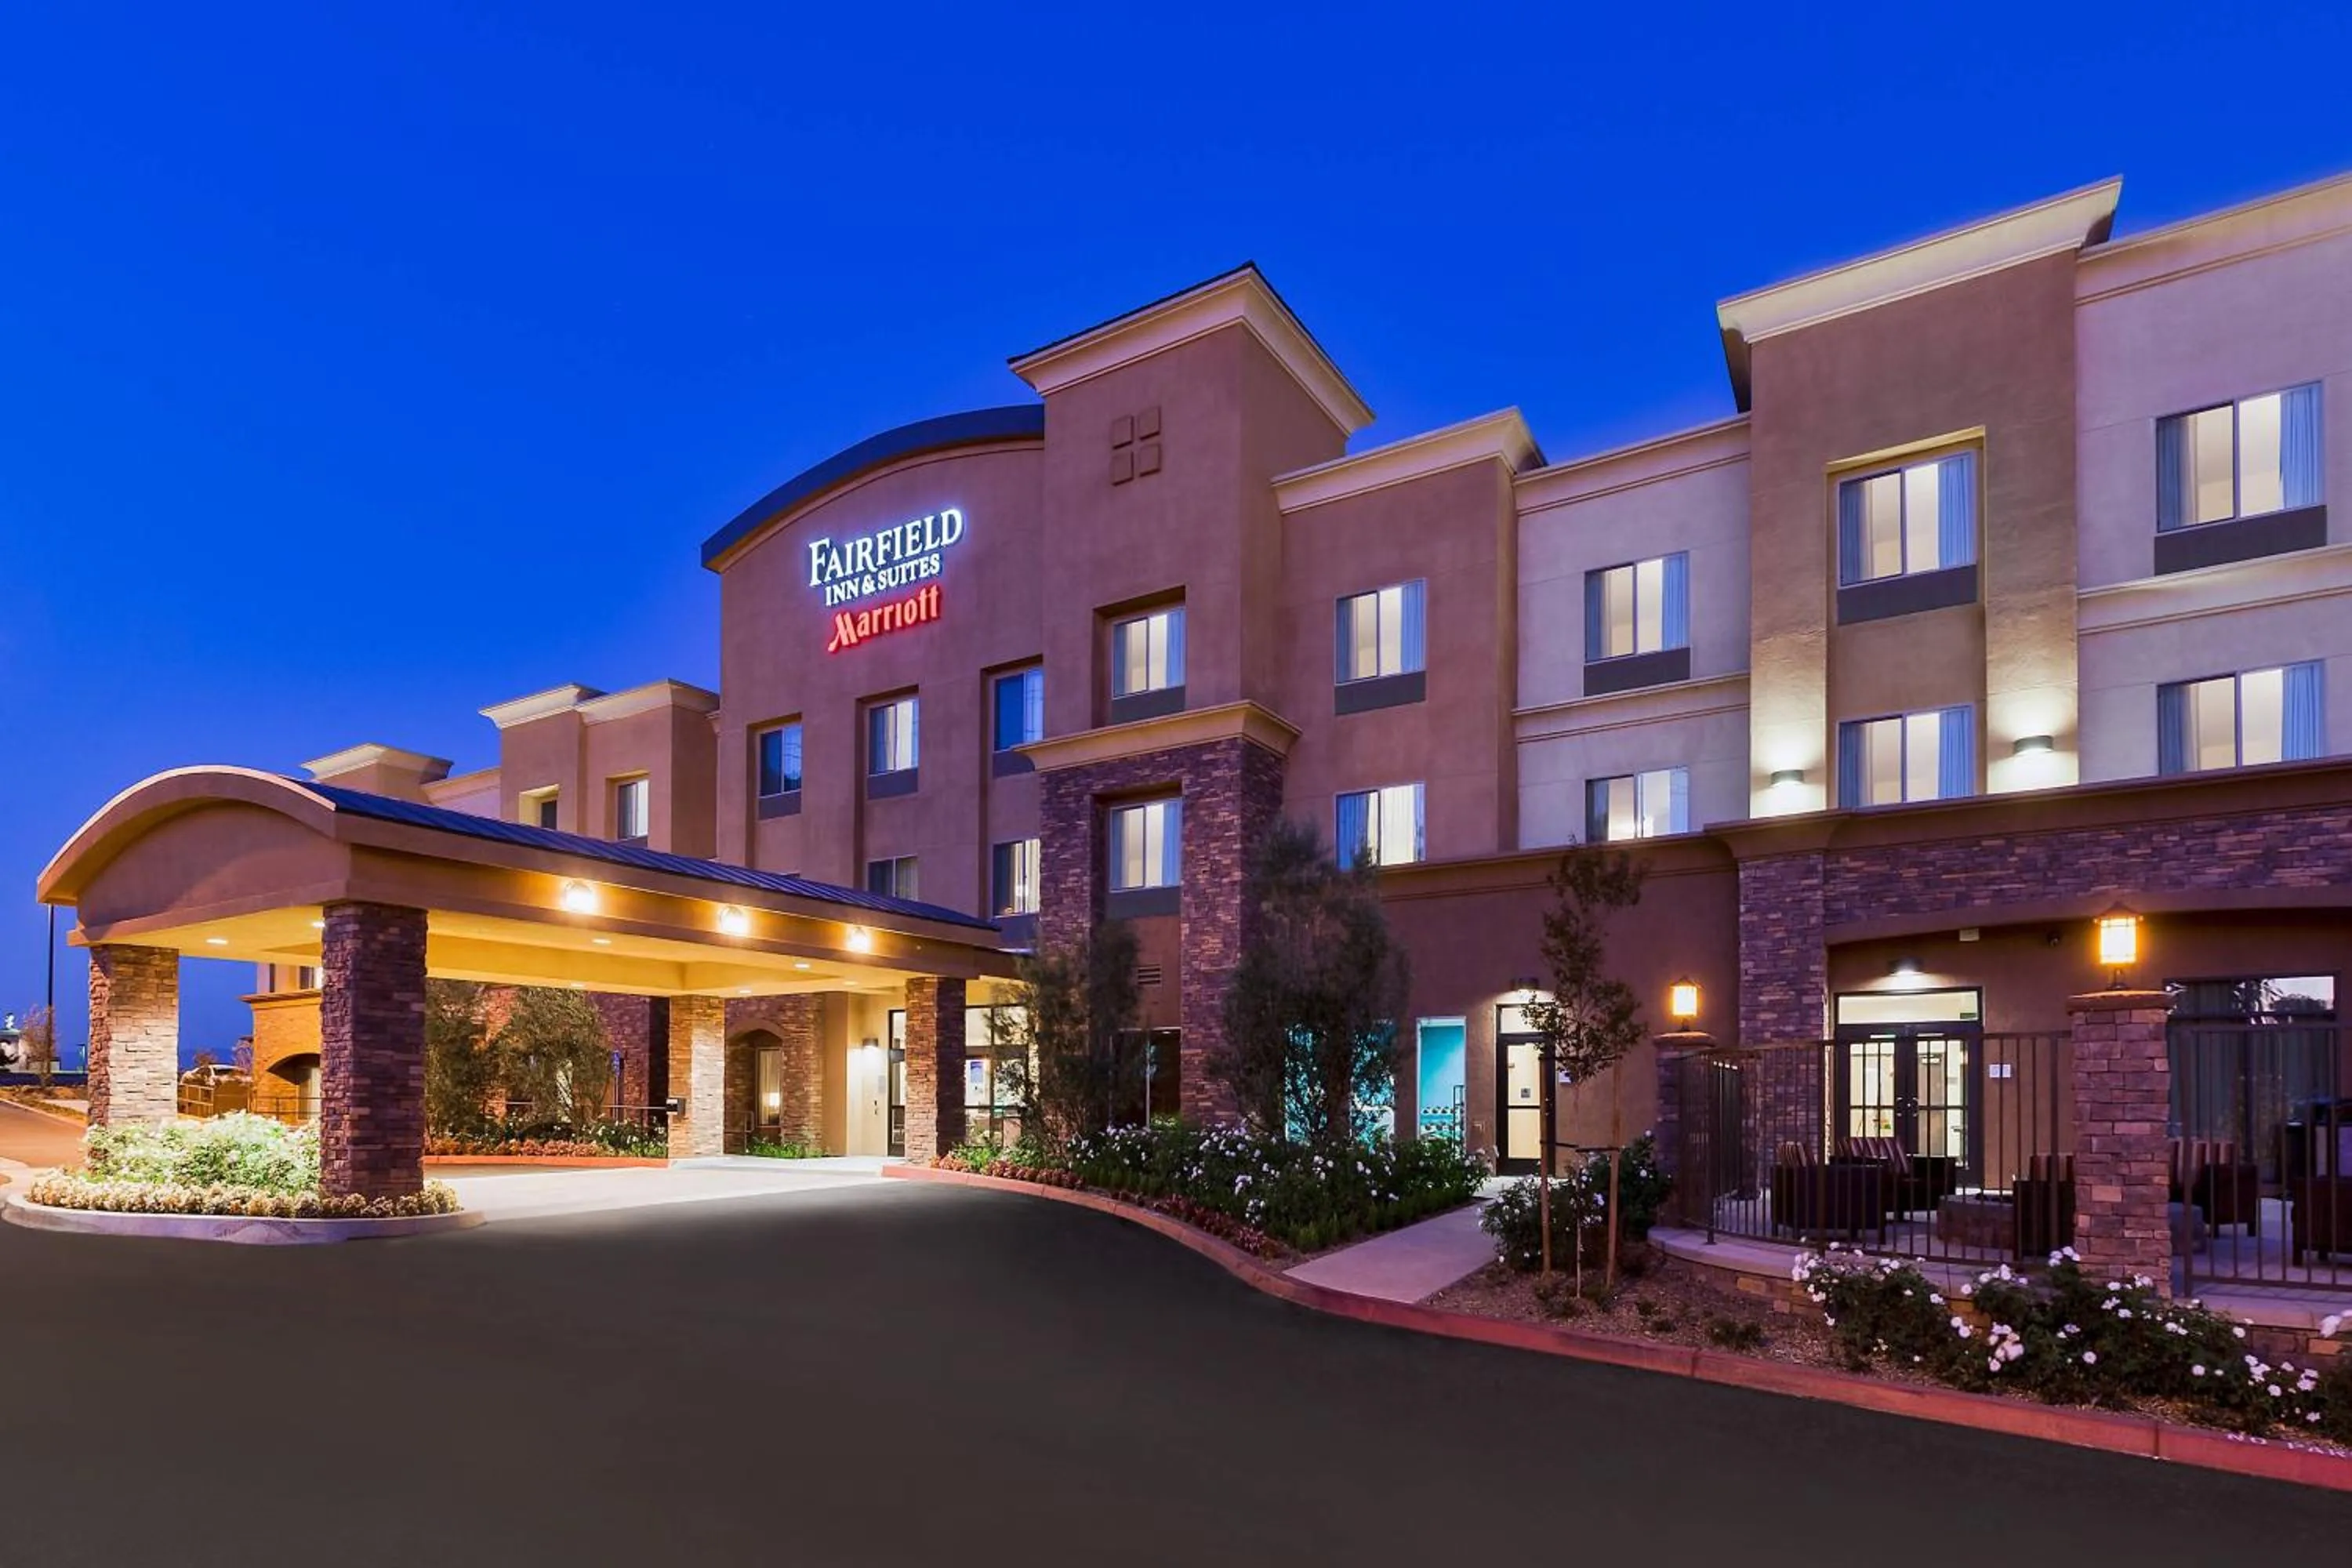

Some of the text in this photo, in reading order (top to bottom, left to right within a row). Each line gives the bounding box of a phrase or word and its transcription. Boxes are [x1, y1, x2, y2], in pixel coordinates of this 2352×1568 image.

[809, 508, 963, 586] FAIRFIELD
[826, 553, 940, 606] INN & SUITES
[827, 584, 939, 652] Marriott
